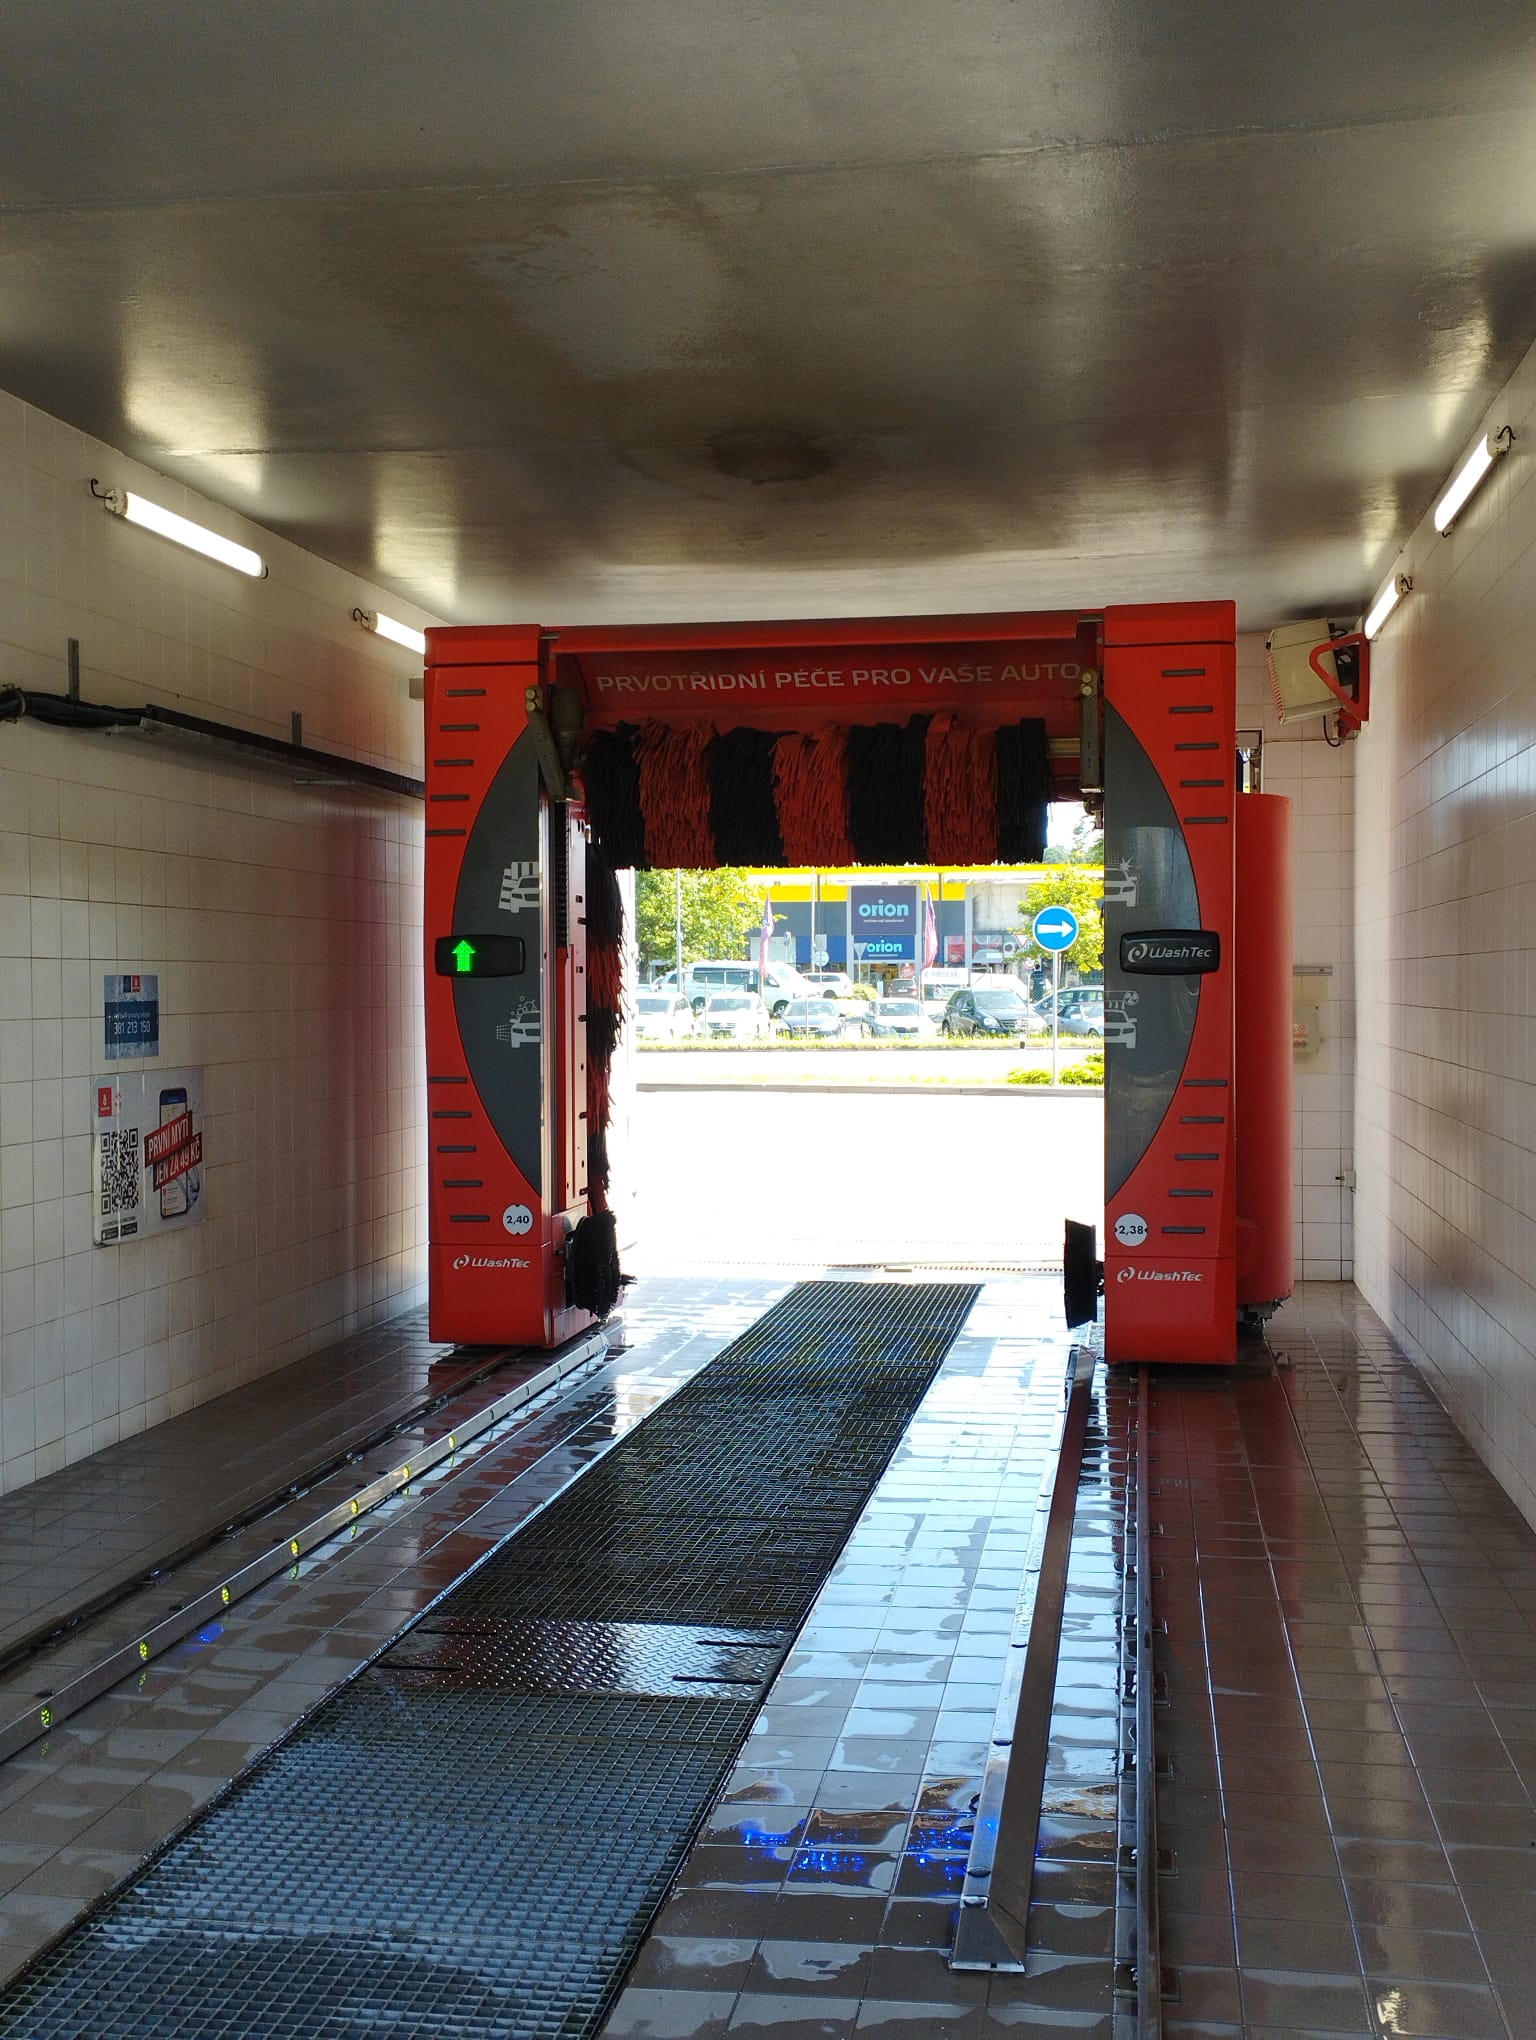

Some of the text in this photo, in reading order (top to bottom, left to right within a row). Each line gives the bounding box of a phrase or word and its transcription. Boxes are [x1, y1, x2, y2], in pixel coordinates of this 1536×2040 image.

[596, 663, 1081, 692] PRVOTŘÍDNÍ PÉČE PRO VAŠE AUTO
[858, 899, 909, 917] orion
[866, 939, 903, 953] orion
[1148, 946, 1212, 958] WashTec
[180, 1146, 190, 1168] 49
[506, 1215, 530, 1225] 2,40
[1118, 1225, 1144, 1236] 2,38
[471, 1258, 531, 1268] WashTec
[1137, 1270, 1204, 1282] WashTec
